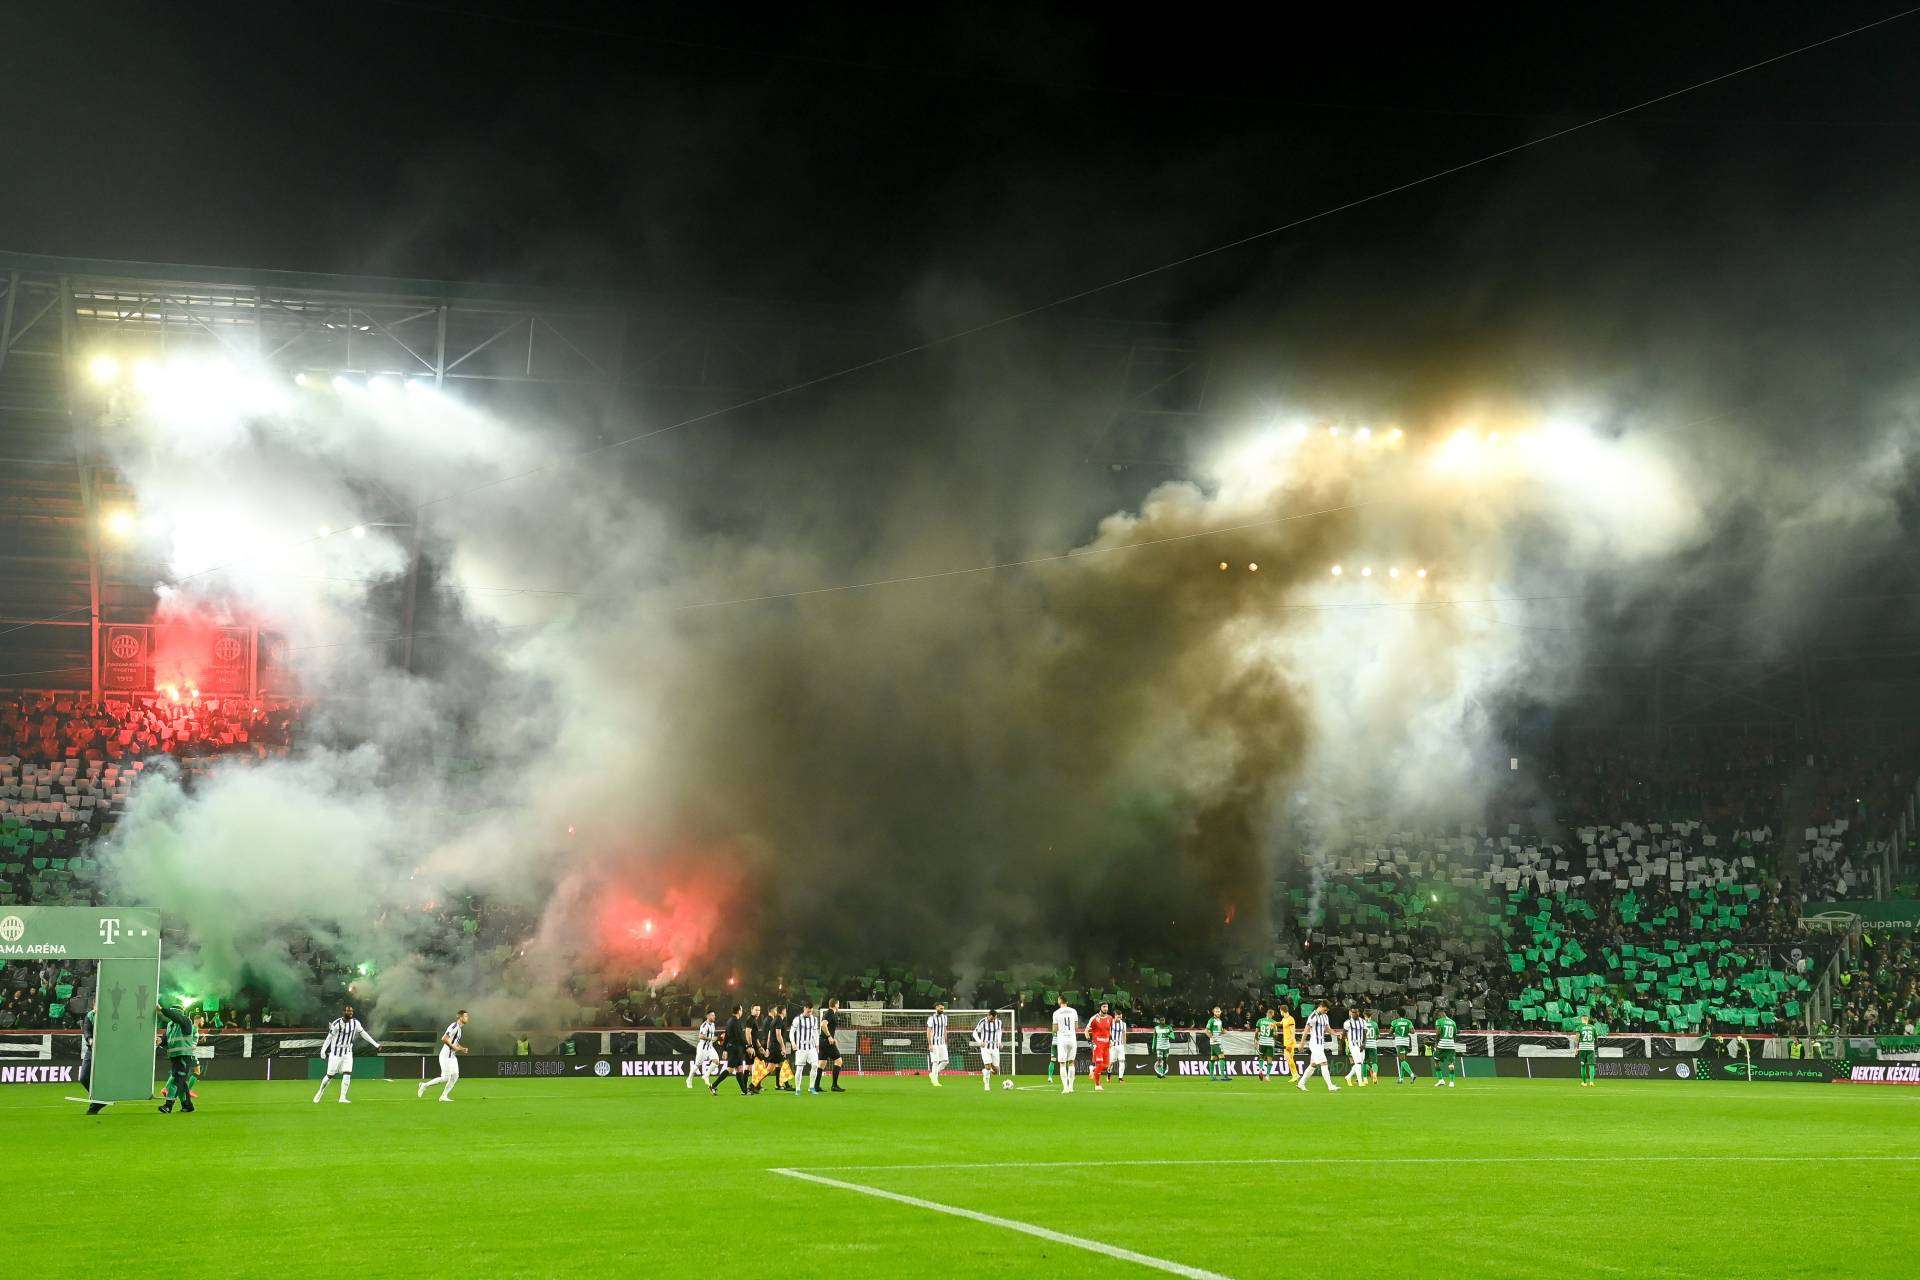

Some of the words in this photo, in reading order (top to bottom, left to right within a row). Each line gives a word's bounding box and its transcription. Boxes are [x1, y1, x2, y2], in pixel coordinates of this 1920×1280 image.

[100, 919, 120, 944] T
[1861, 920, 1912, 931] oupama
[26, 942, 66, 954] ARÉNA
[1064, 1016, 1070, 1031] 4
[1261, 1025, 1271, 1037] 93
[1400, 1026, 1406, 1037] 7
[1444, 1025, 1454, 1038] 70
[1582, 1030, 1593, 1042] 26
[2, 1066, 72, 1082] NEKTEK
[497, 1061, 532, 1075] FRADI
[535, 1061, 565, 1075] SHOP
[622, 1060, 684, 1076] NEKTEK
[1179, 1060, 1238, 1075] NEKTK
[1598, 1062, 1622, 1076] RADI
[1624, 1062, 1651, 1076] SHOP
[1851, 1066, 1886, 1081] NEKTEK
